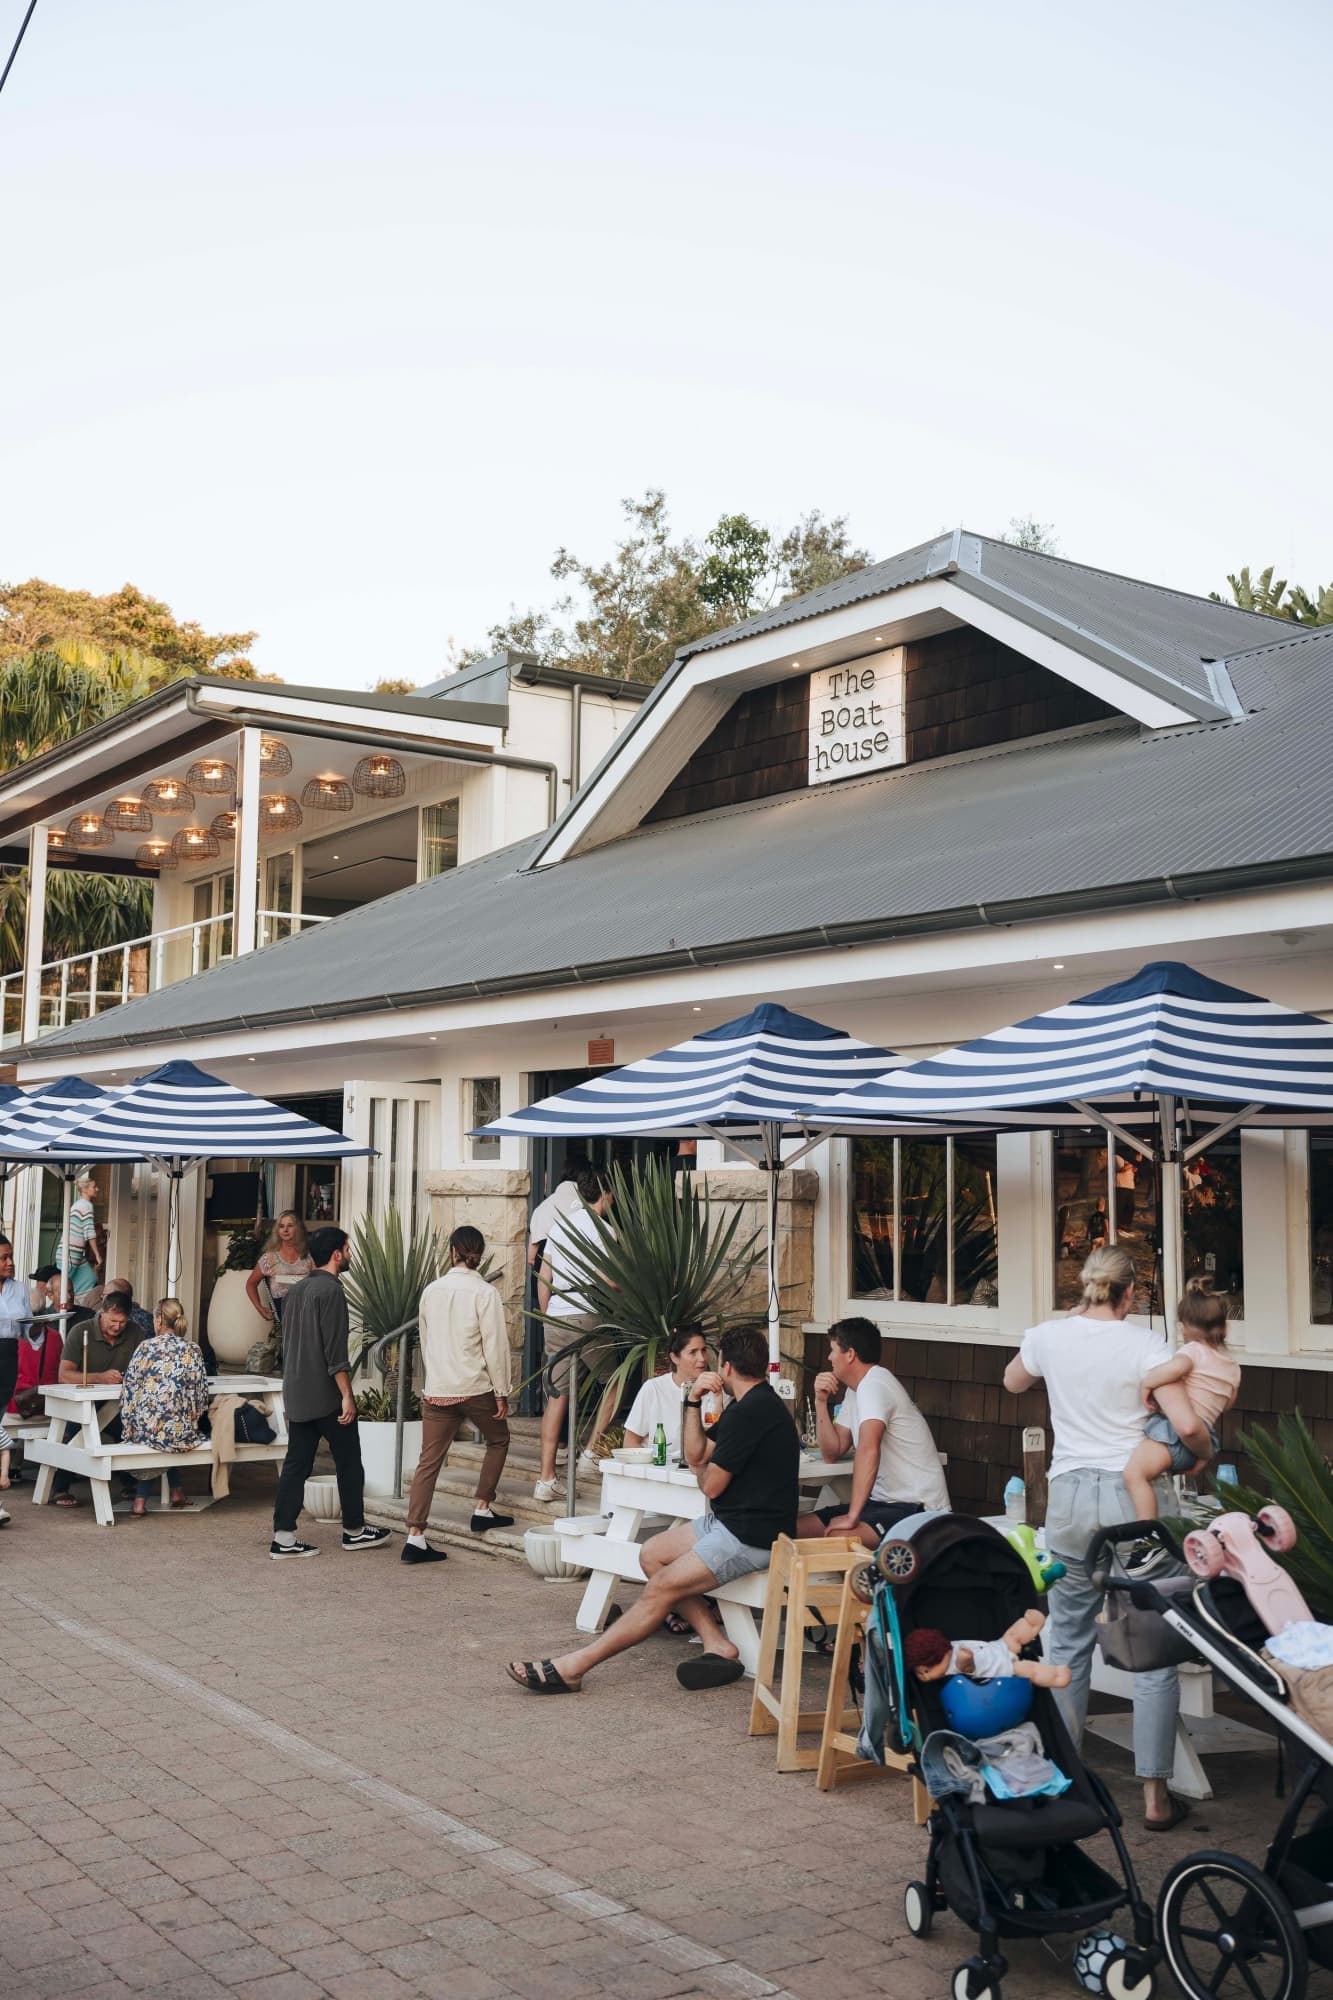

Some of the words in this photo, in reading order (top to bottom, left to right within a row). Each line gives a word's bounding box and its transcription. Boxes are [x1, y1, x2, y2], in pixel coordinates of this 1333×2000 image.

[828, 669, 875, 700] The
[820, 700, 883, 737] Boat
[815, 731, 889, 772] house
[779, 1385, 791, 1395] 43
[1028, 1433, 1041, 1446] 77
